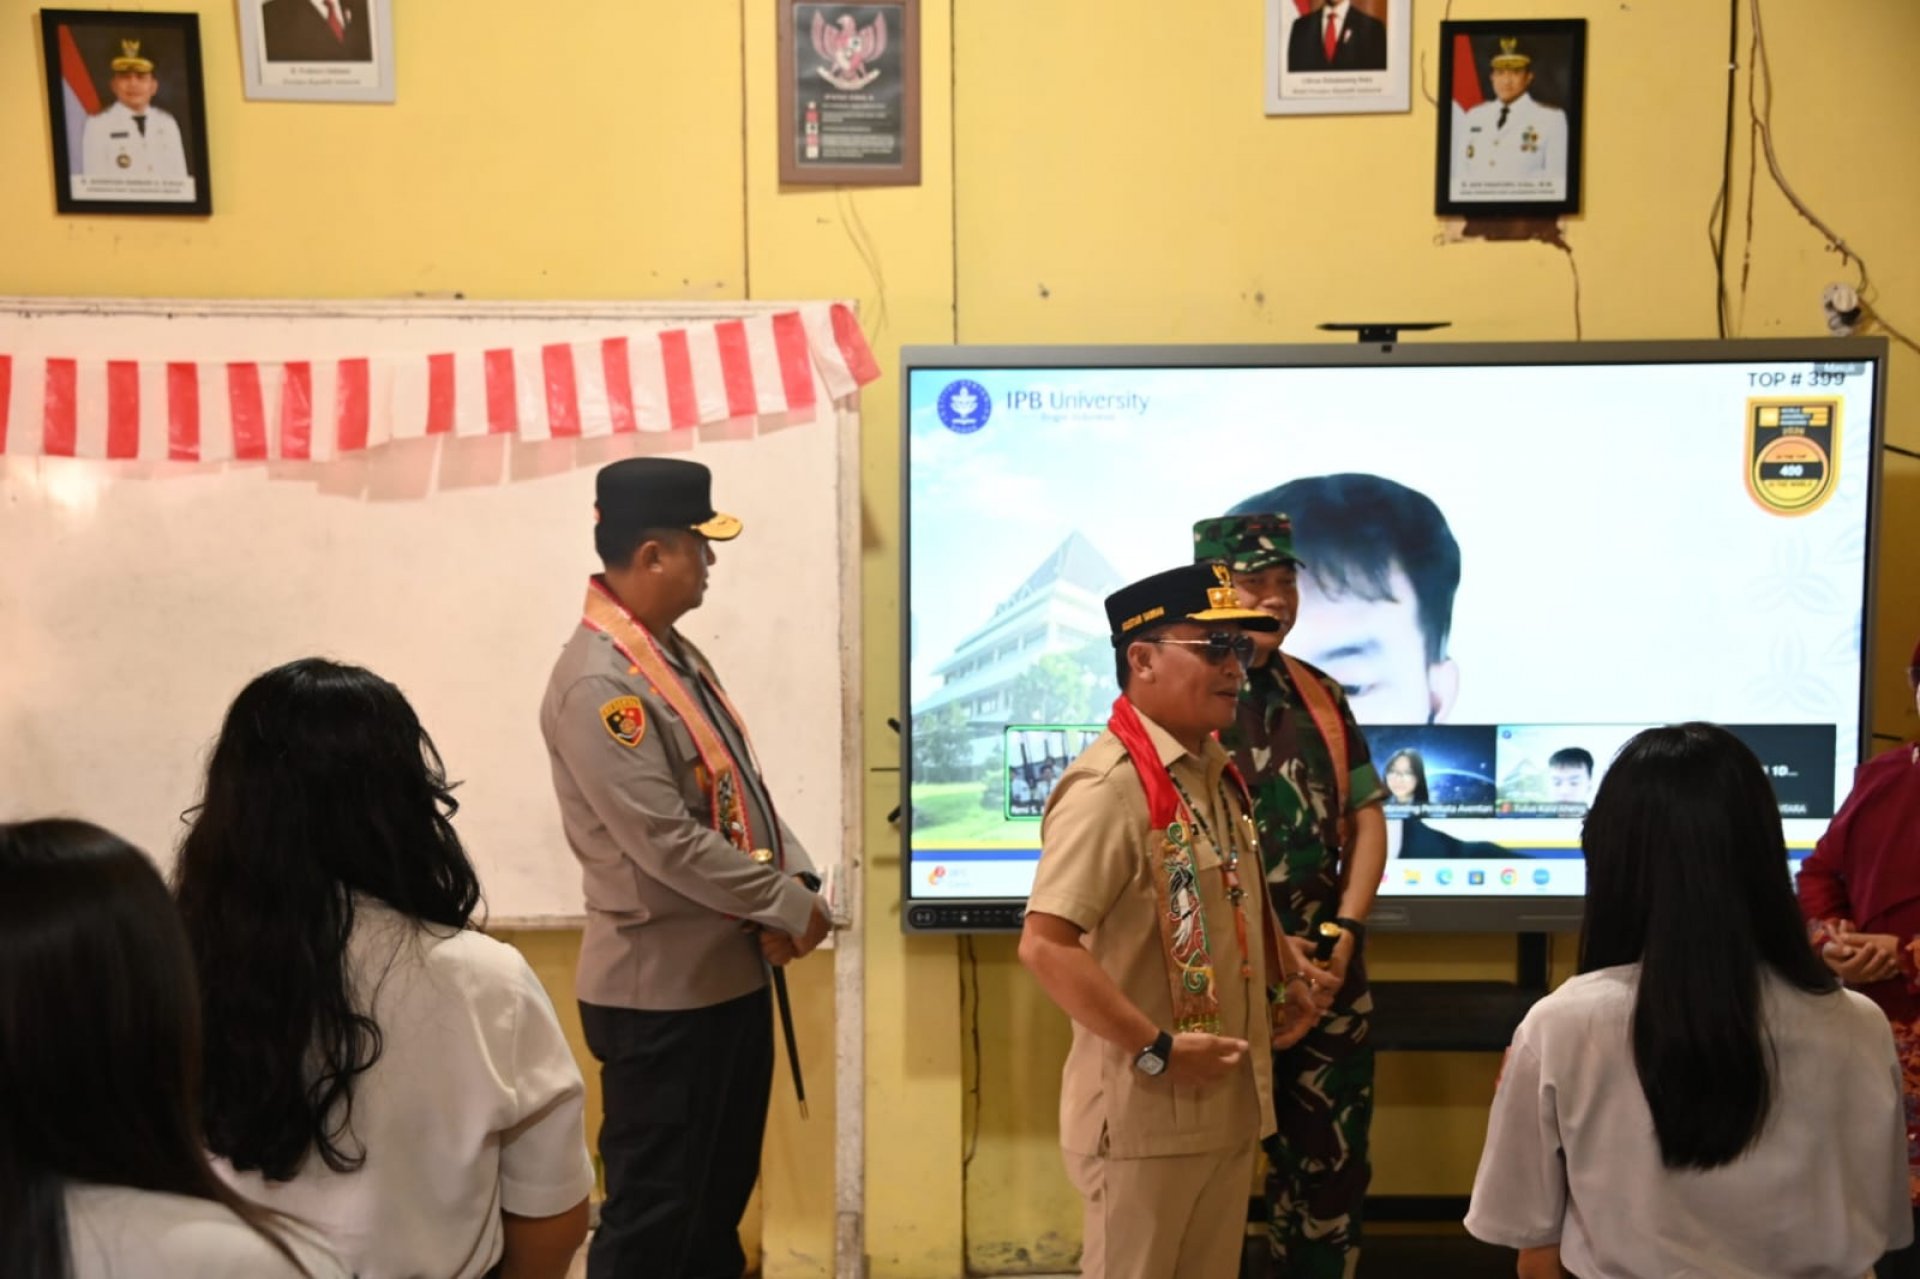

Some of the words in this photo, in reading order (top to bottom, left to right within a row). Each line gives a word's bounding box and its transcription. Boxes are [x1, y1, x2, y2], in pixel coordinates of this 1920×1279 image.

[1748, 372, 1786, 387] TOP
[1790, 373, 1802, 386] #
[1808, 371, 1845, 386] 399
[1006, 391, 1042, 410] IPB
[1050, 390, 1150, 415] University
